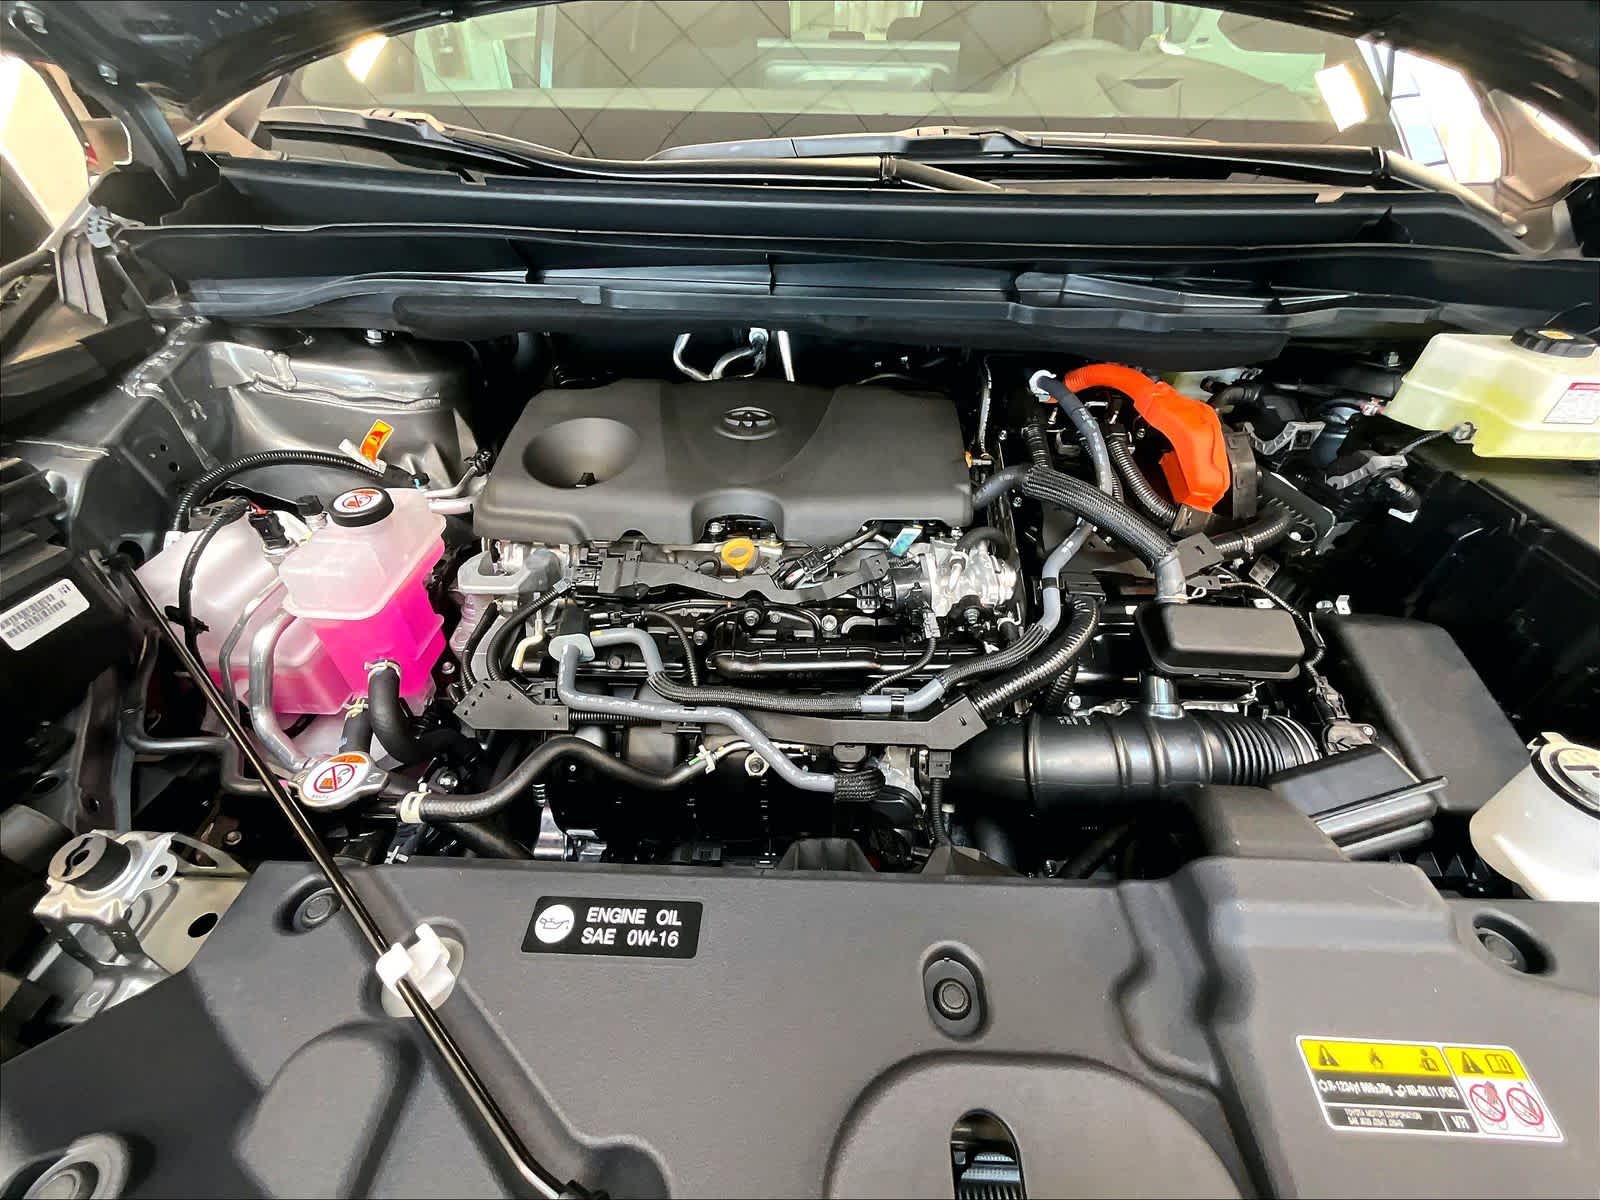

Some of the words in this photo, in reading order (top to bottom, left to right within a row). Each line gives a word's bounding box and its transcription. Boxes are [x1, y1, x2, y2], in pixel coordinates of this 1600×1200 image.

[586, 907, 647, 925] ENGINE
[655, 910, 682, 926] OIL
[581, 928, 617, 945] SAE
[627, 930, 680, 948] 0W-16
